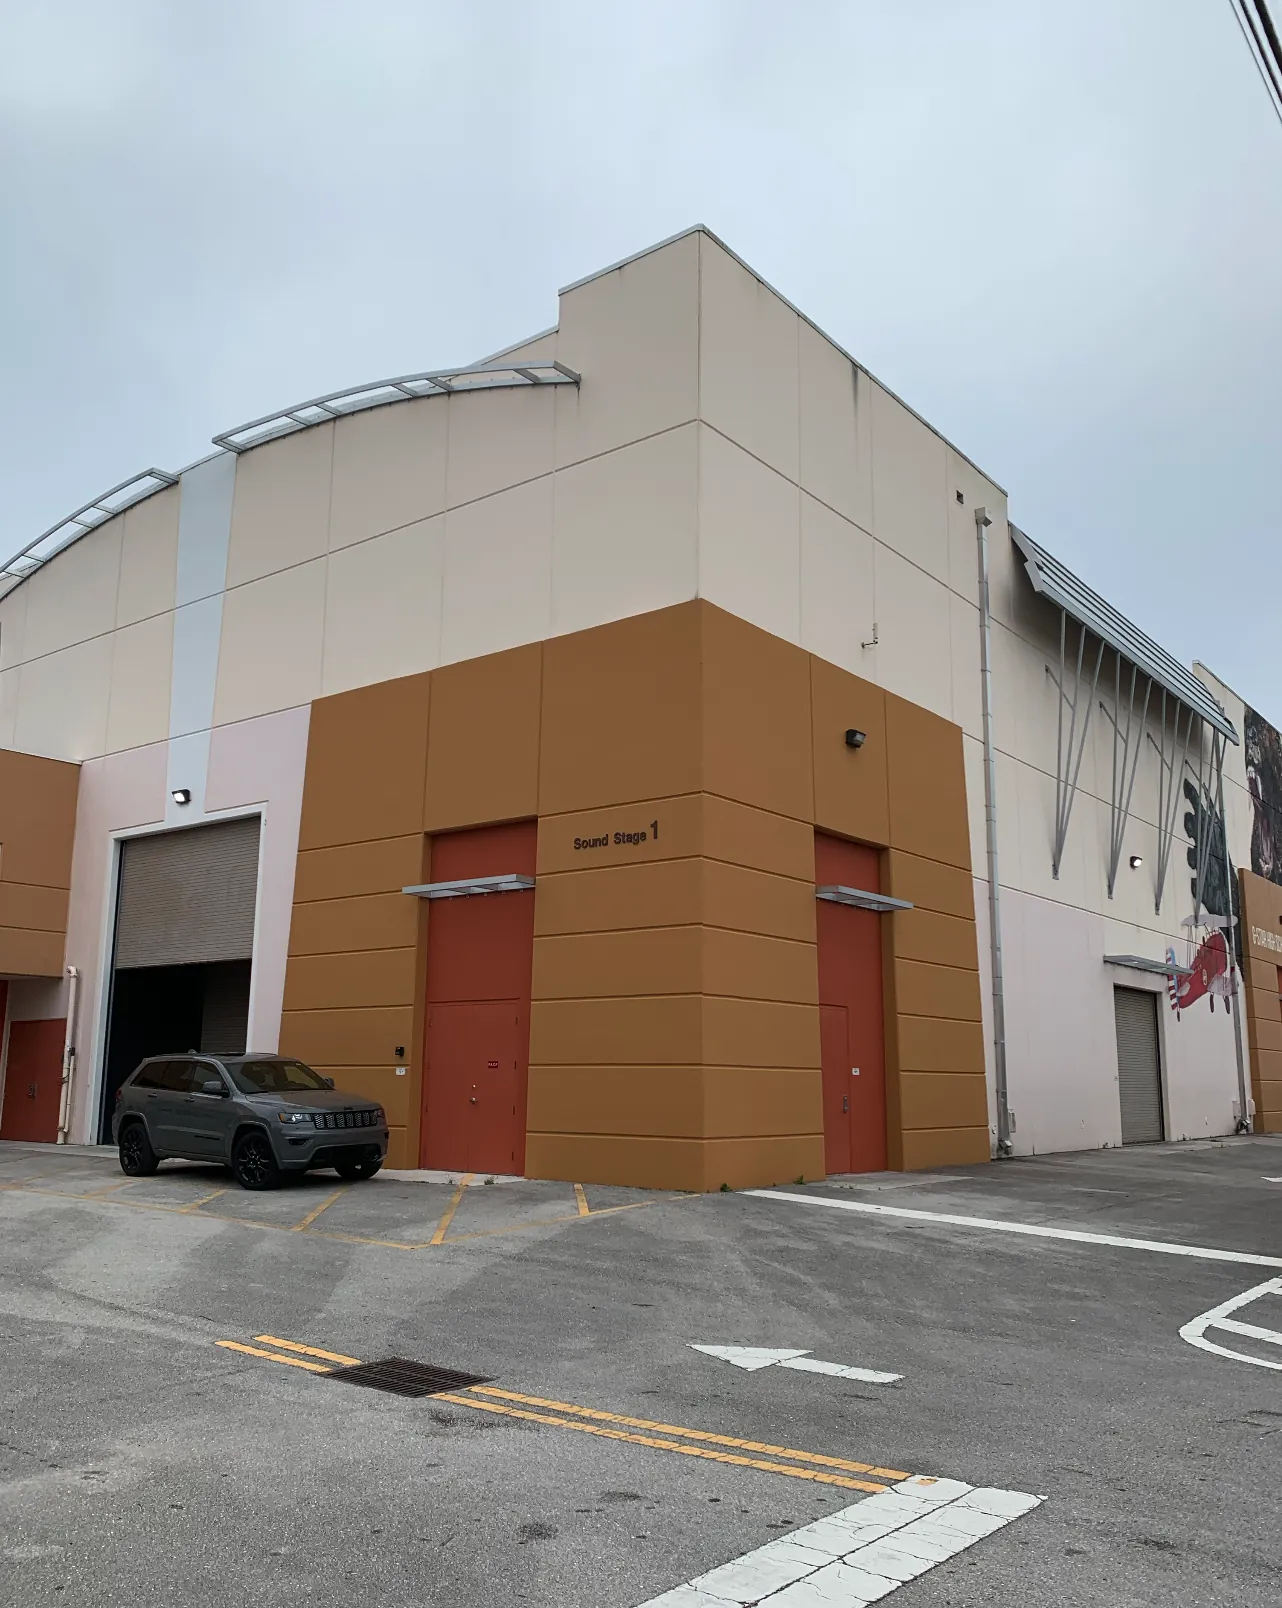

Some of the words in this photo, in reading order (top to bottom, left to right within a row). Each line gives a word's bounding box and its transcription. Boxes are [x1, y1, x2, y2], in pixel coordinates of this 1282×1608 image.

[574, 834, 609, 850] Sound
[614, 831, 647, 845] Stage
[650, 820, 658, 840] 1
